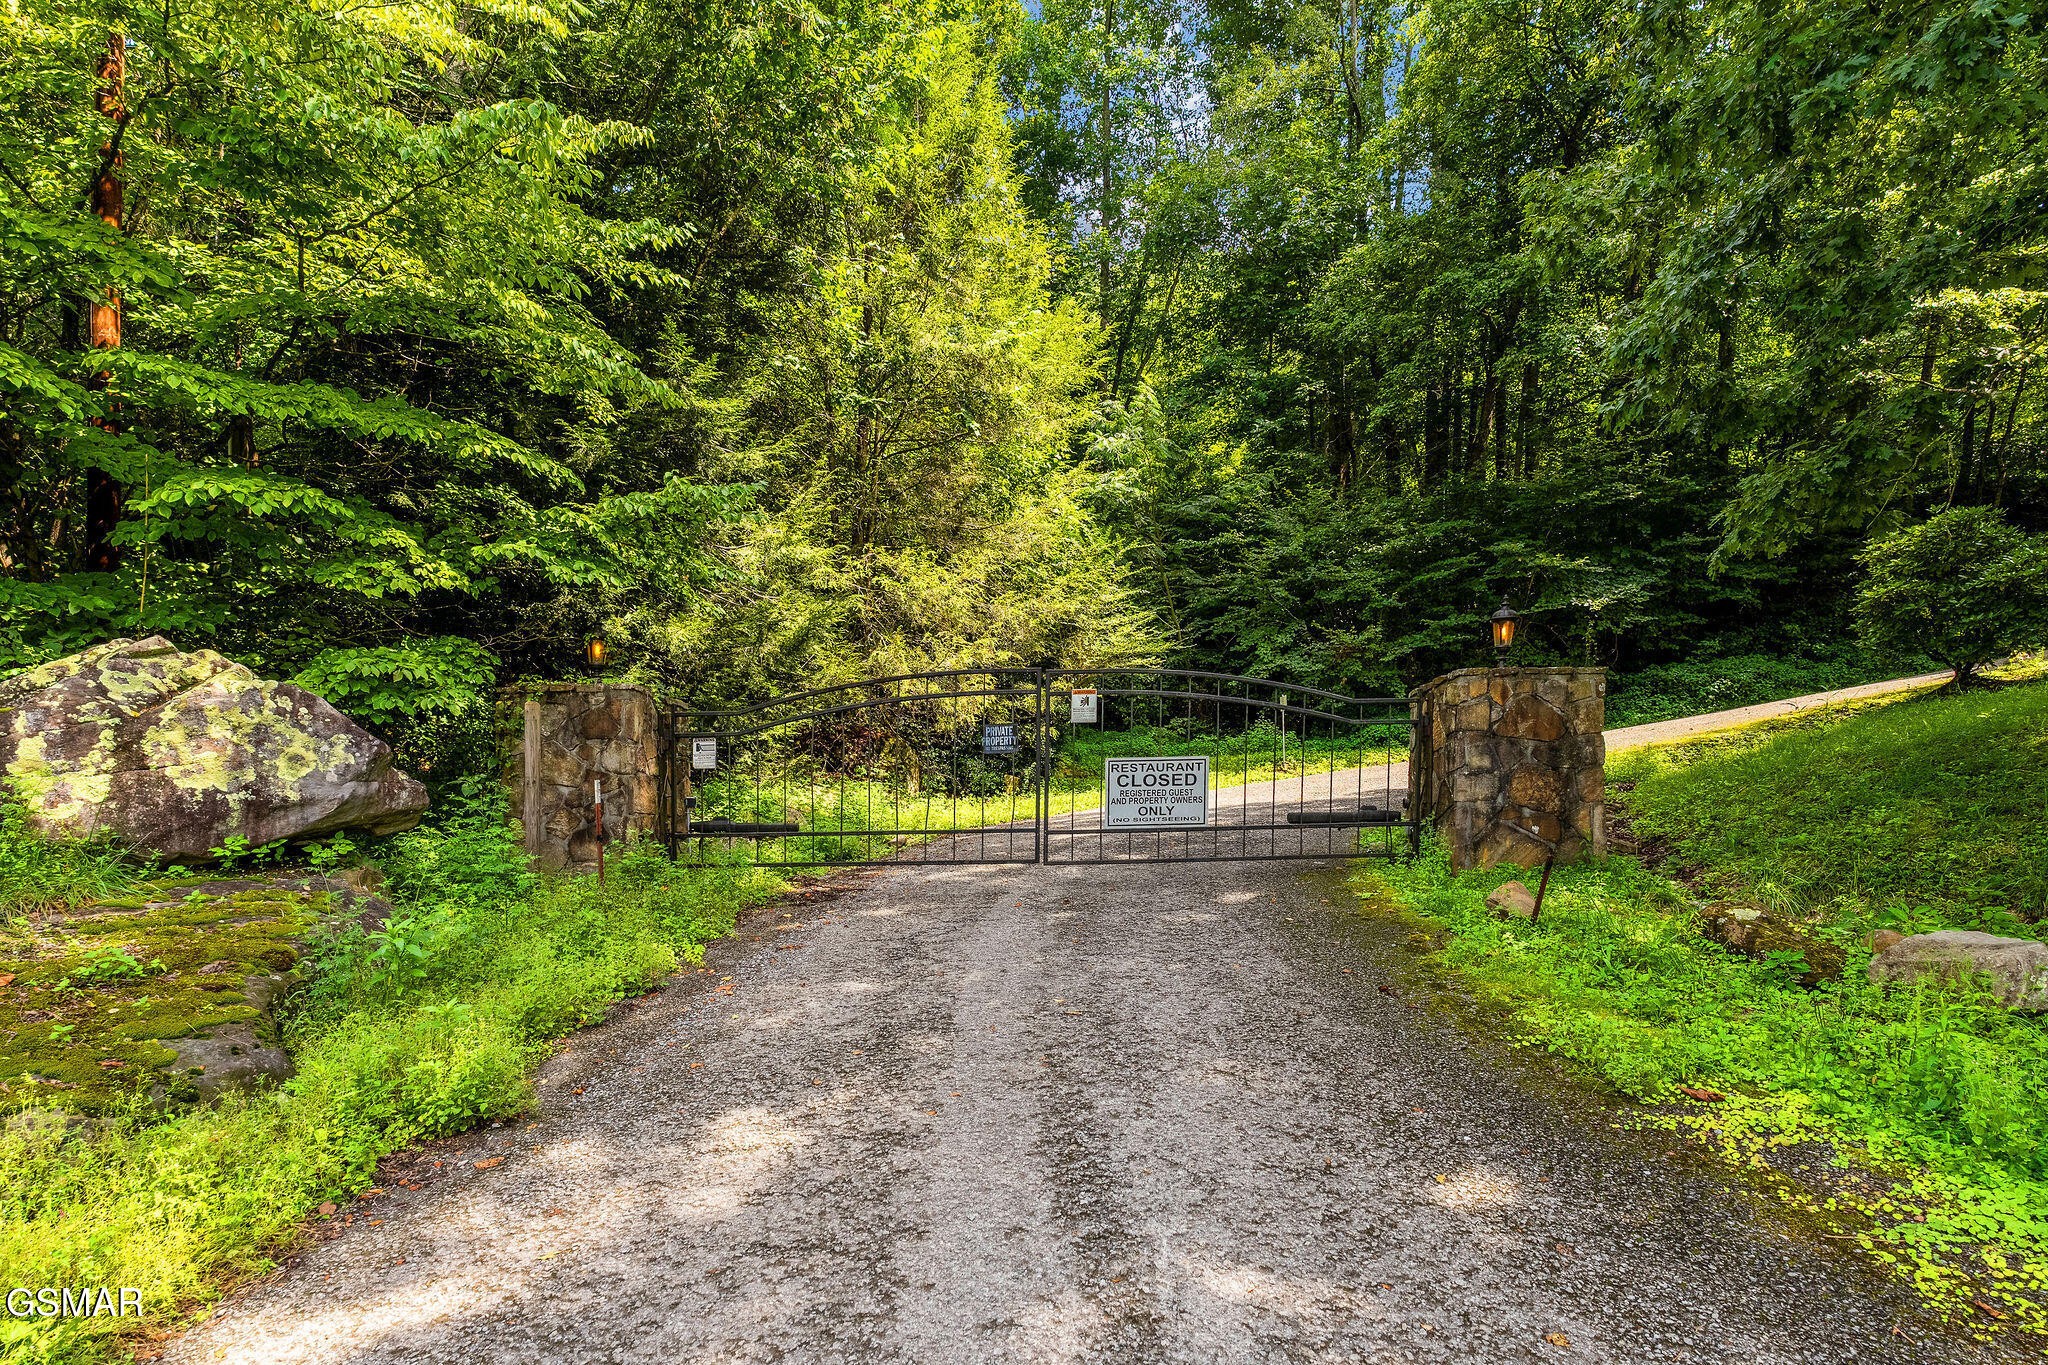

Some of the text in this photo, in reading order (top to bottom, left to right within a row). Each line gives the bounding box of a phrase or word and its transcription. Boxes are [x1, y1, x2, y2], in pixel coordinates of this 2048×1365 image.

[985, 726, 1013, 736] PRIVATE
[982, 736, 1017, 746] PROPERTY
[1111, 762, 1203, 773] RESTAURANT
[1116, 773, 1197, 787] CLOSED
[1119, 788, 1194, 797] REGISTERED GUEST
[1111, 796, 1203, 805] AND PROPERTY OWNERS
[1138, 806, 1175, 816] ONLY
